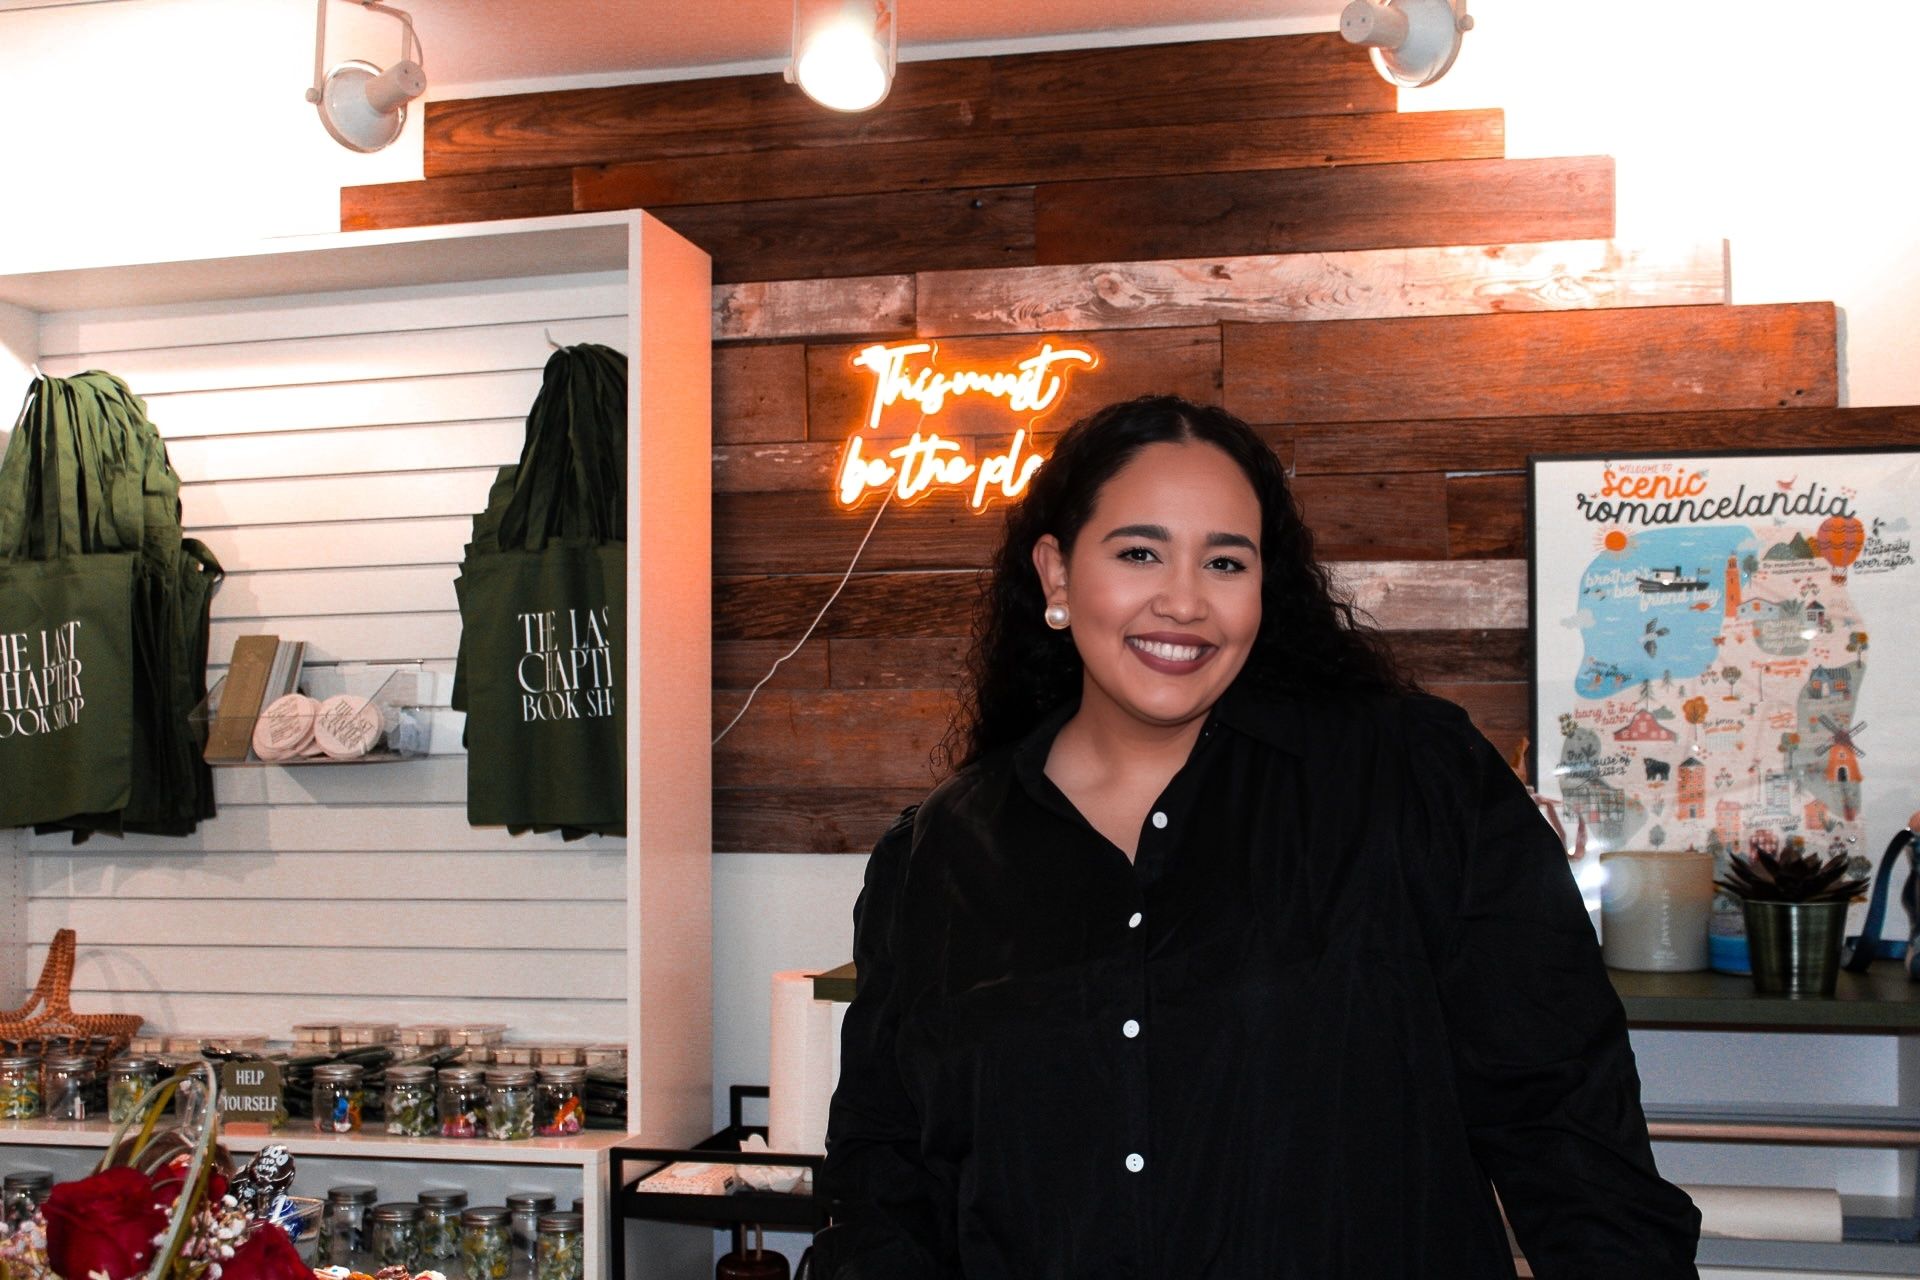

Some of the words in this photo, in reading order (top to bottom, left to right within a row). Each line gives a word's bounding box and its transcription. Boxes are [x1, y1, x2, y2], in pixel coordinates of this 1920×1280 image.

[853, 343, 952, 428] This
[950, 344, 1092, 411] must
[841, 436, 896, 504] be
[889, 432, 976, 499] the
[1601, 467, 1707, 499] scenic
[1619, 464, 1658, 474] WELCOME
[1577, 482, 1856, 525] romancelandia
[518, 610, 558, 654] THE
[522, 691, 580, 722] BOOK
[586, 688, 614, 718] SH
[236, 1069, 265, 1086] HELP
[223, 1095, 279, 1112] YOURSELF
